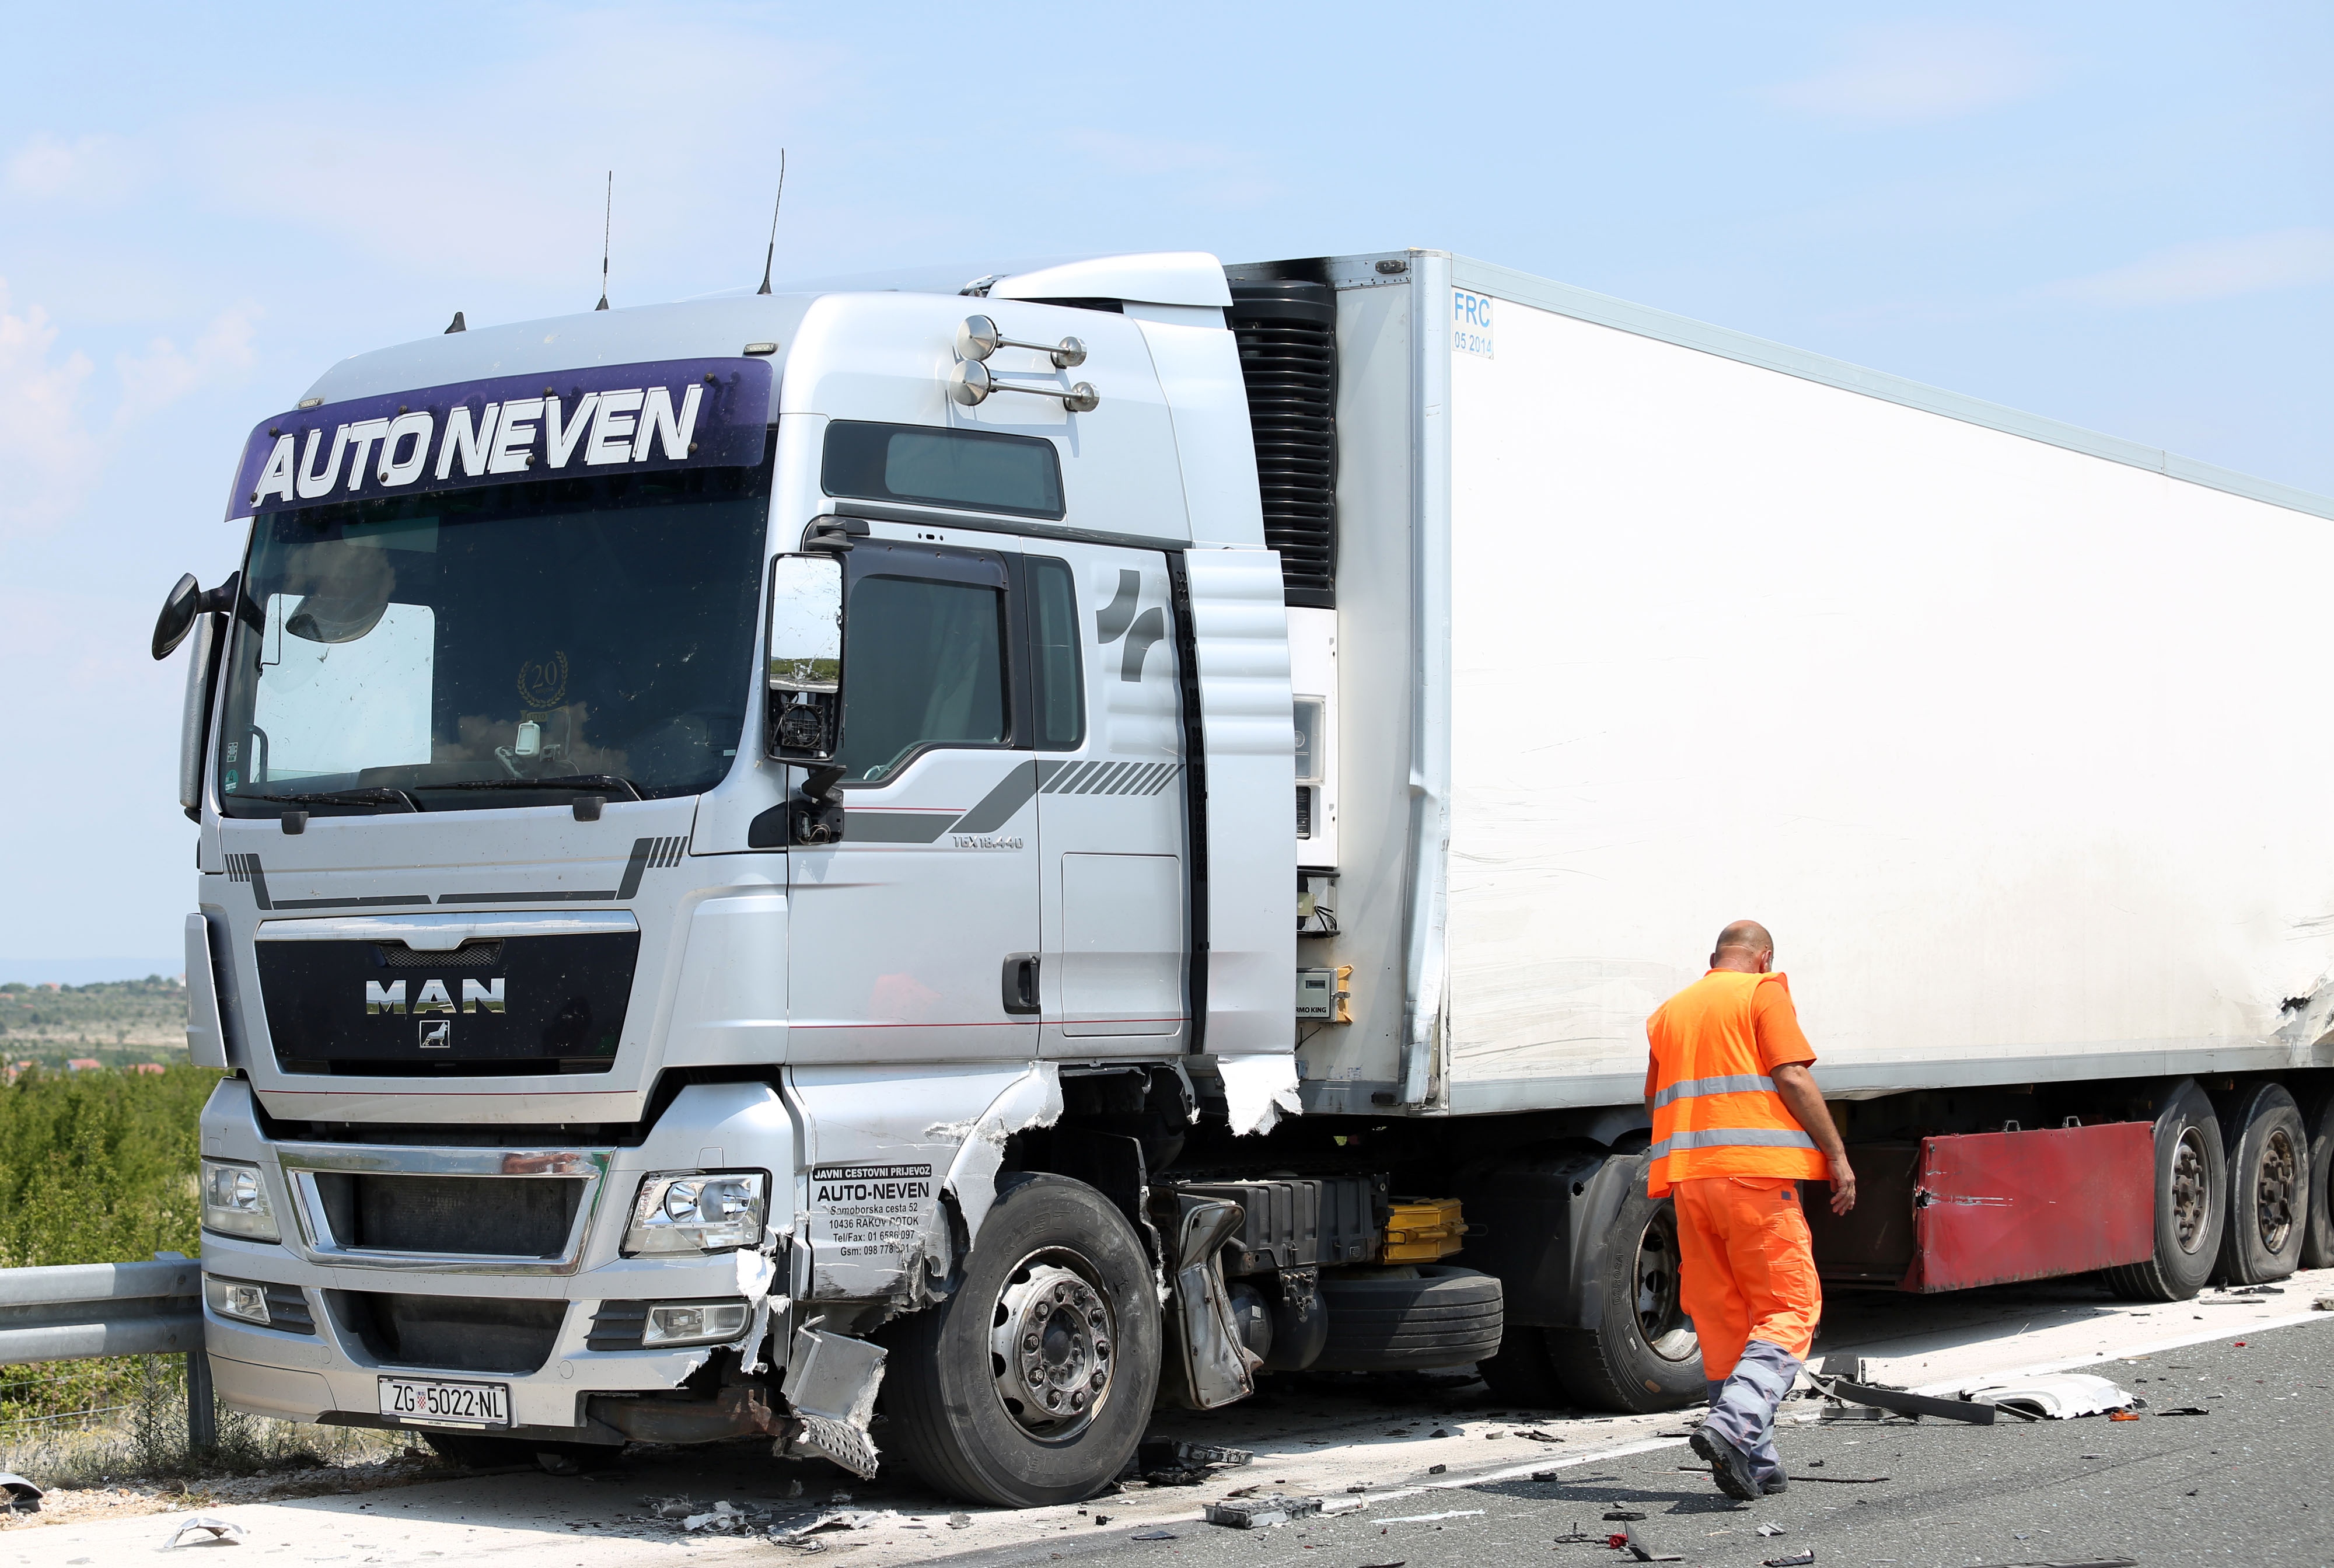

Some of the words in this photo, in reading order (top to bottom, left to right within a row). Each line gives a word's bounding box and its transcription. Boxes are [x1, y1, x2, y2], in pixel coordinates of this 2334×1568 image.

[1455, 292, 1490, 327] FRC
[1455, 331, 1466, 349] 05
[1469, 334, 1492, 354] 2014
[251, 411, 434, 508] AUTO
[436, 383, 703, 480] NEVEN
[532, 661, 557, 689] 20
[366, 977, 505, 1015] MAN
[815, 1169, 843, 1179] JAVNI
[845, 1167, 888, 1178] CESTOVNI
[890, 1166, 931, 1176] PRIJEVOZ
[817, 1182, 930, 1202] AUTO-NEVEN
[830, 1204, 883, 1216] Samoborska
[886, 1203, 906, 1213] cesta
[909, 1202, 918, 1212] 52
[829, 1219, 854, 1229] 10436
[856, 1217, 886, 1228] RAKOV
[833, 1232, 865, 1242] Tel/Fax:
[868, 1231, 876, 1241] 01
[900, 1230, 915, 1239] 097
[840, 1246, 861, 1256] Gsm:
[864, 1246, 878, 1255] 098
[880, 1244, 893, 1254] 778
[393, 1385, 415, 1412] ZG
